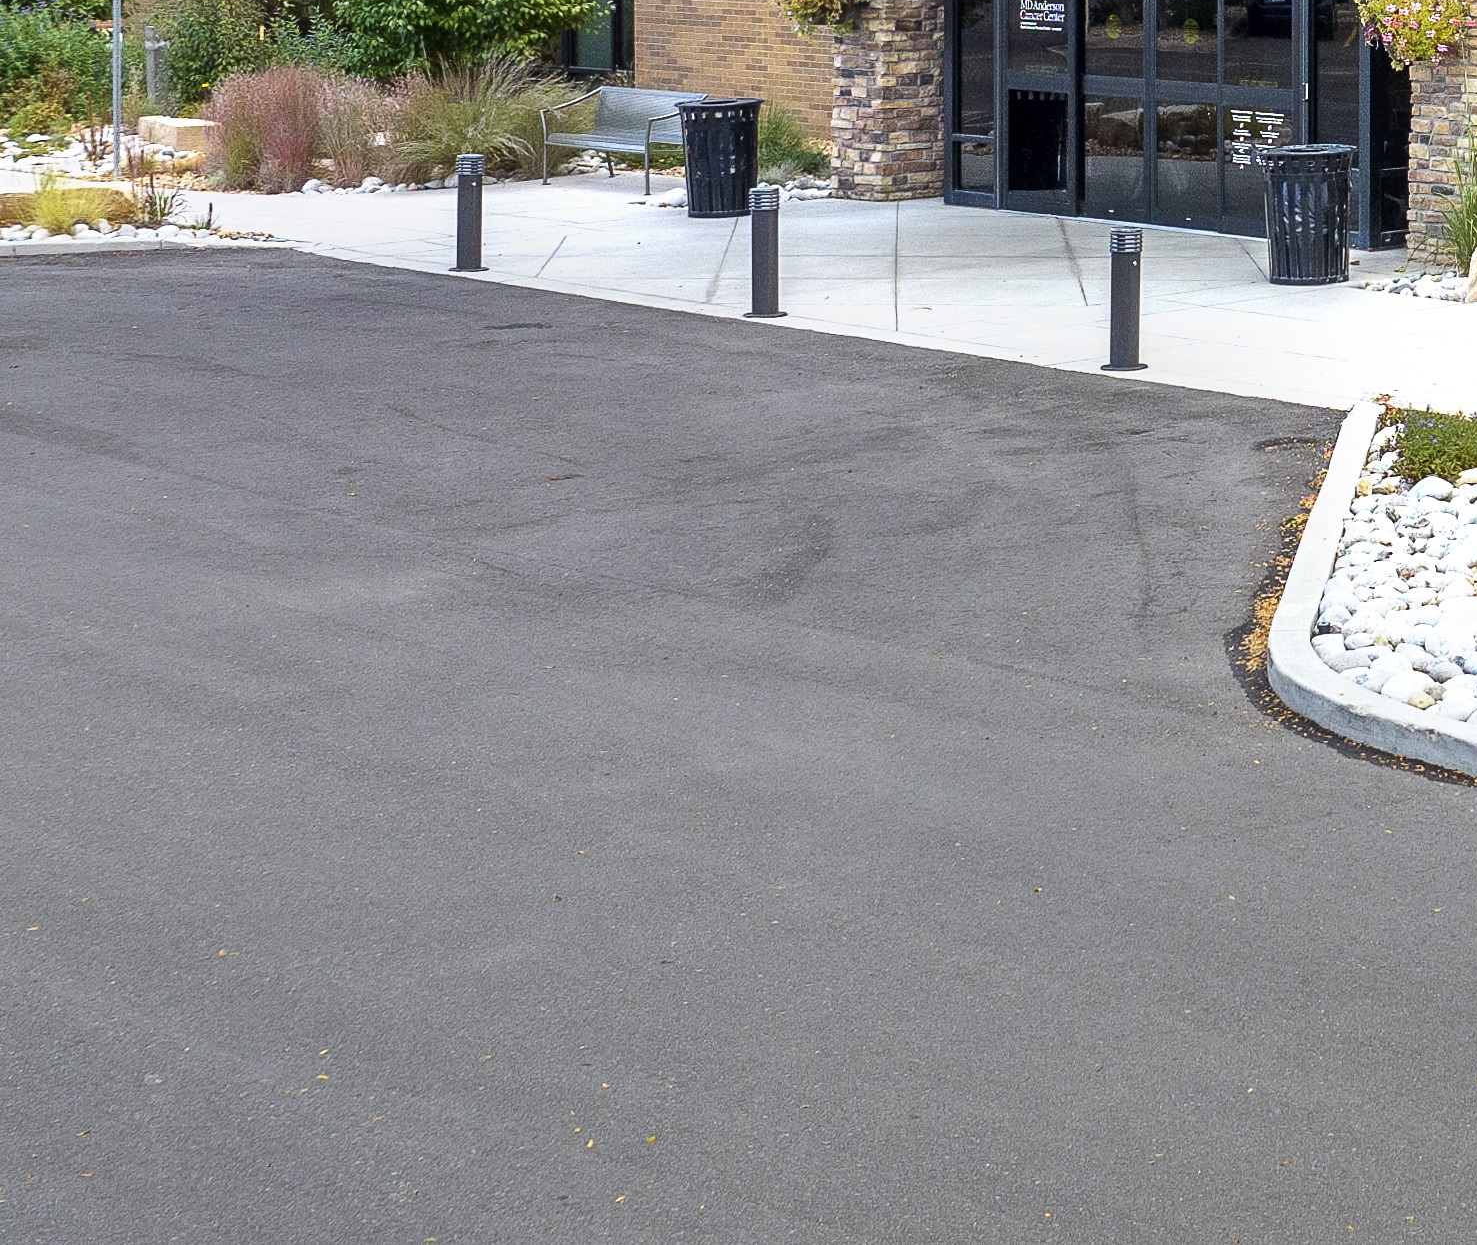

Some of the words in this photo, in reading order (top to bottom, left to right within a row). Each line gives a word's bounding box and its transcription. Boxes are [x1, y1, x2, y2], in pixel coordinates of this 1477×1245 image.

[1020, 0, 1033, 10] MD
[1033, 0, 1064, 12] Anderson
[1043, 11, 1065, 22] Center
